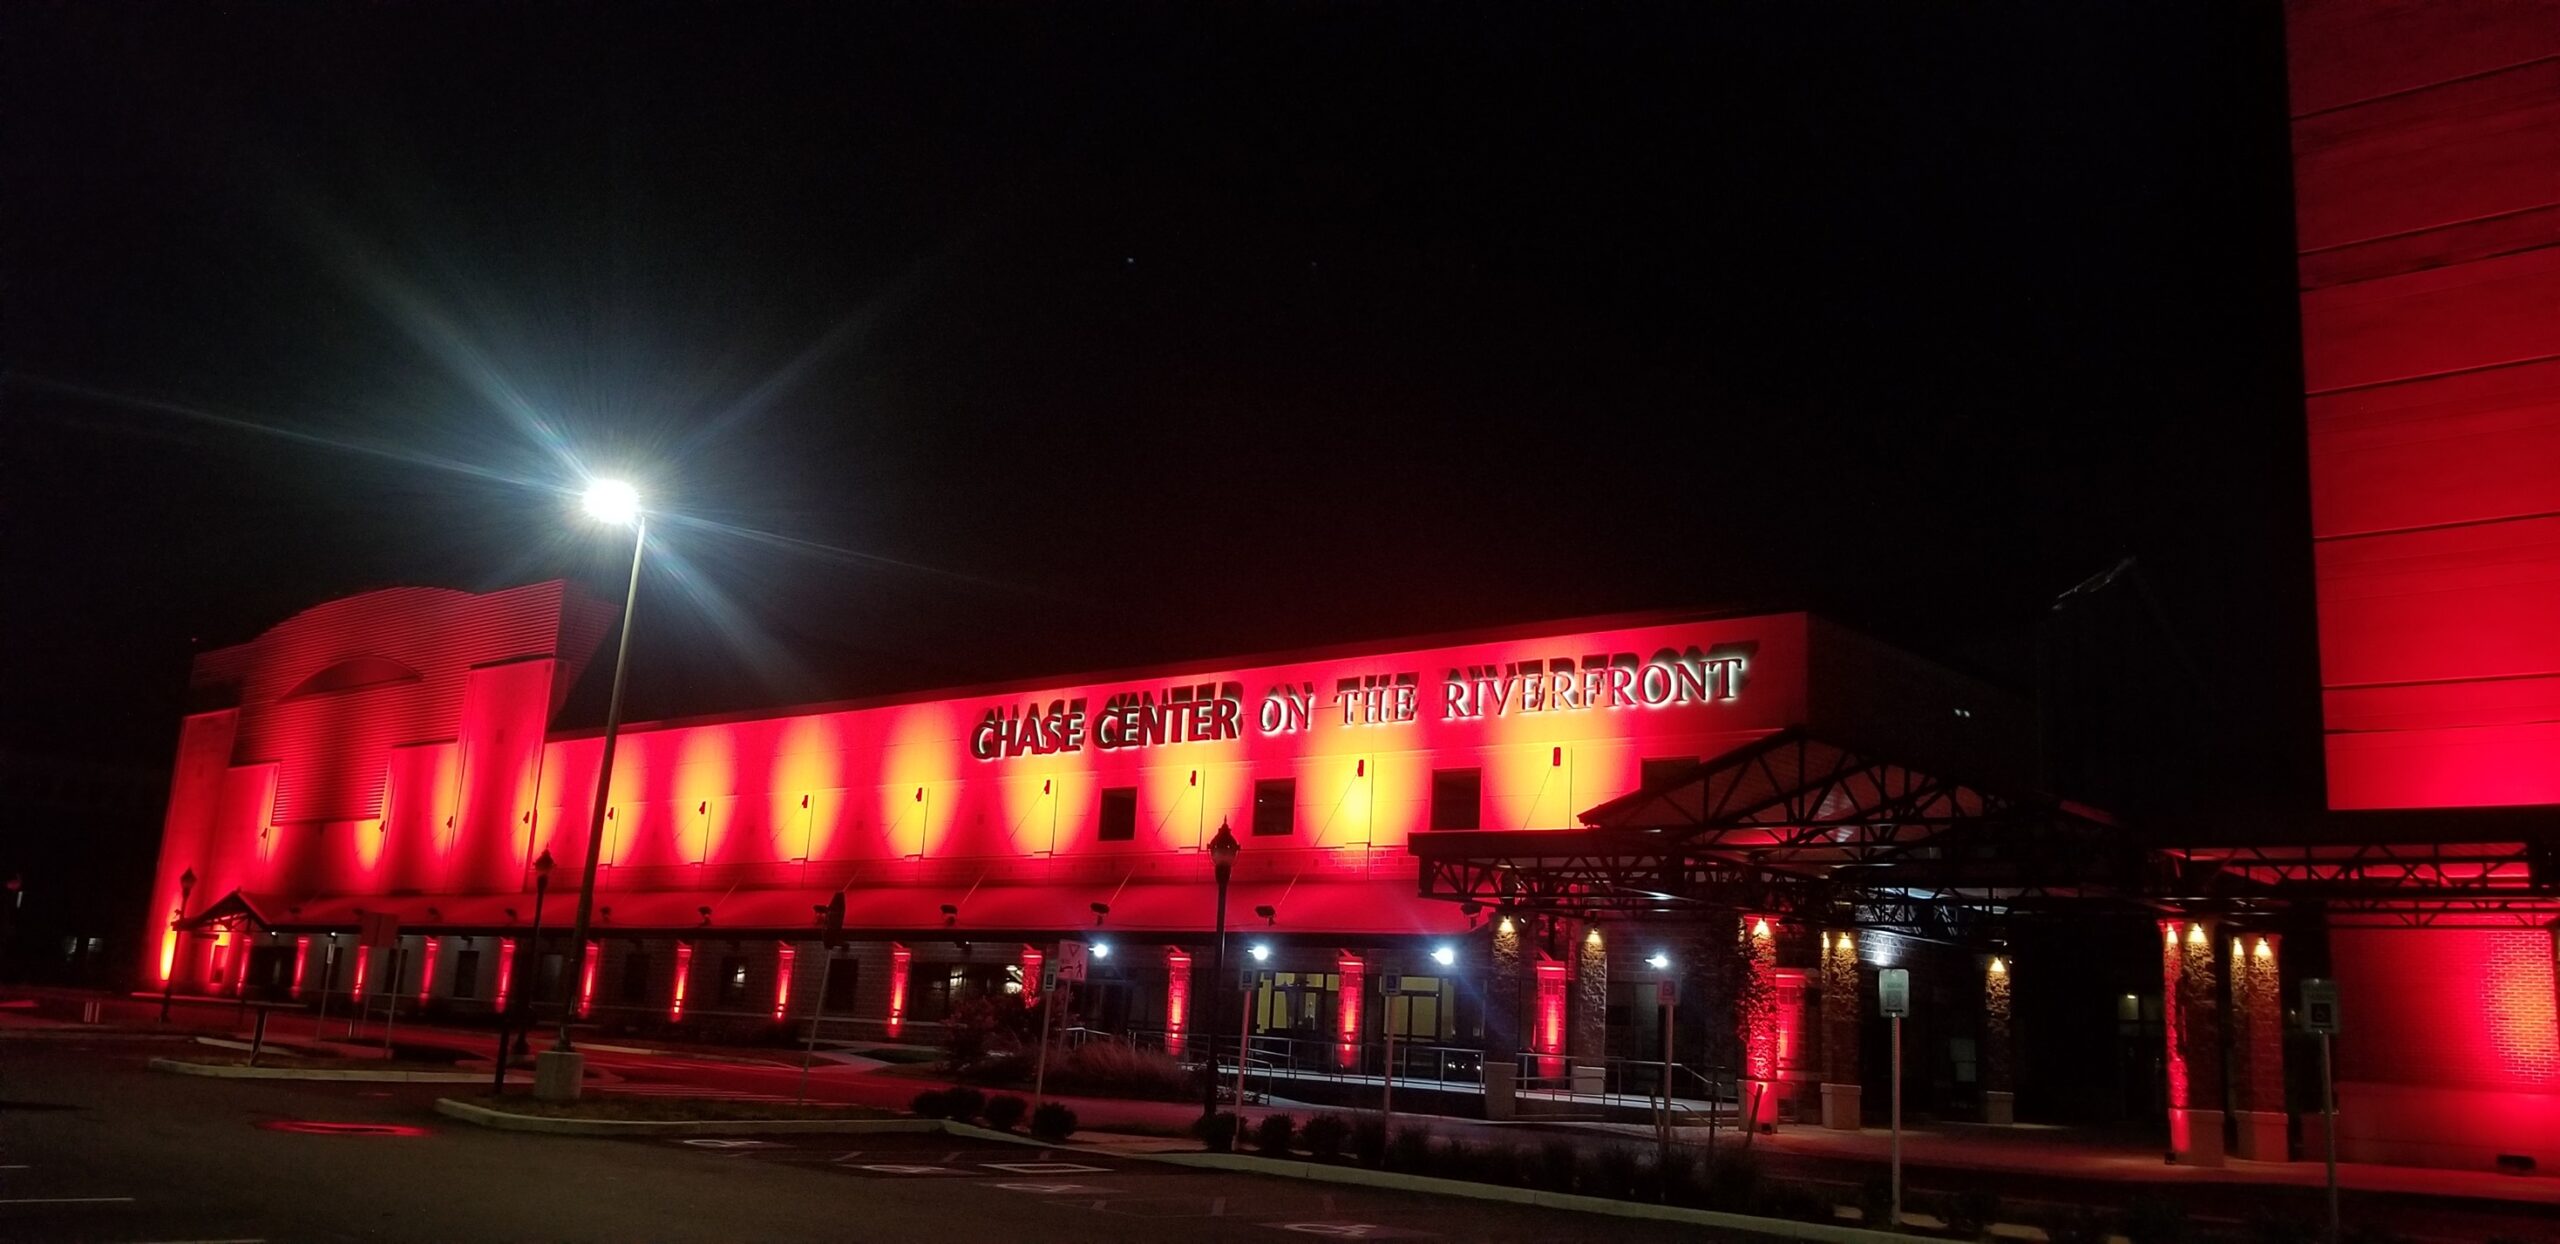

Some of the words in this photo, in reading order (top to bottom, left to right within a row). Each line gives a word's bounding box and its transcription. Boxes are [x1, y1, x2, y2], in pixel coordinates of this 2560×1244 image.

[970, 711, 1084, 760] CHASE
[1091, 698, 1237, 750] CENTER
[1259, 693, 1313, 735] ON
[1334, 684, 1417, 726] THE
[1440, 657, 1743, 720] RIVERFRONT
